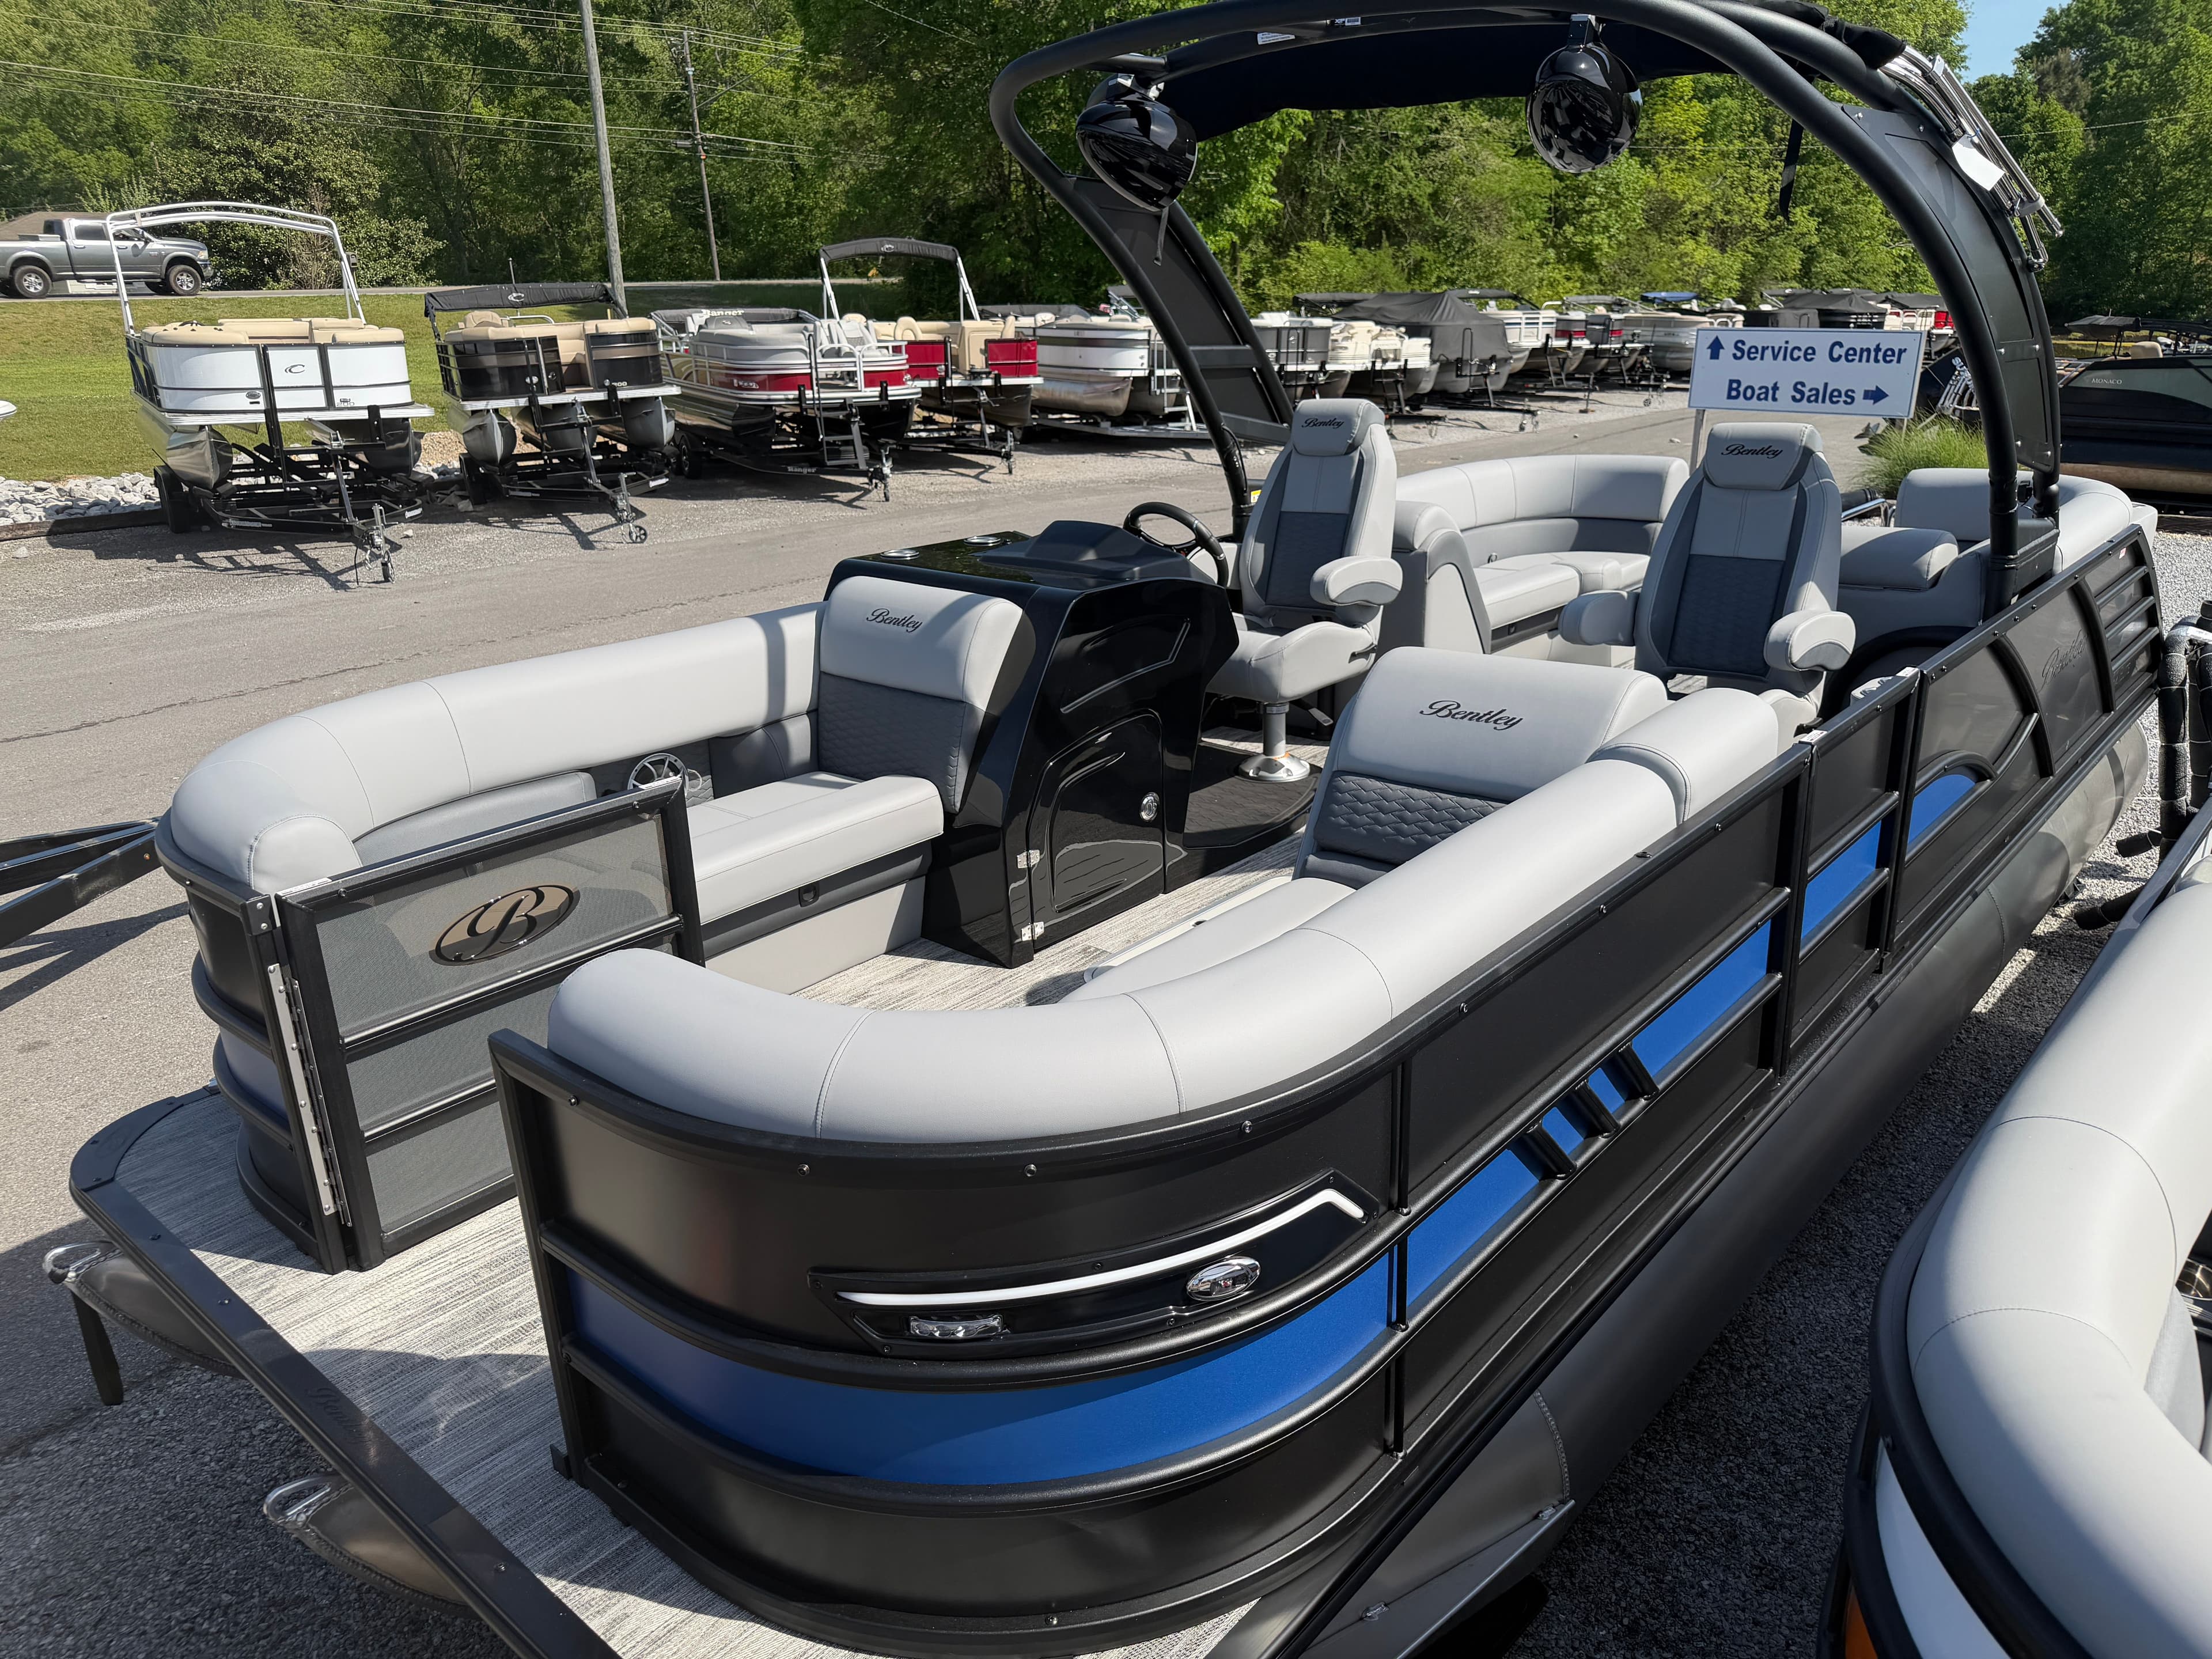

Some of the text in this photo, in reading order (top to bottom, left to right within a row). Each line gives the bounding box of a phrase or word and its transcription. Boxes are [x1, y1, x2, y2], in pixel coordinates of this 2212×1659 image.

[1732, 339, 1907, 364] Service Center
[1726, 378, 1855, 405] Boat Sales
[1301, 417, 1345, 429] Bentley
[1721, 444, 1783, 459] Bentley
[866, 608, 923, 633] Bentley
[1419, 700, 1524, 731] Bentley
